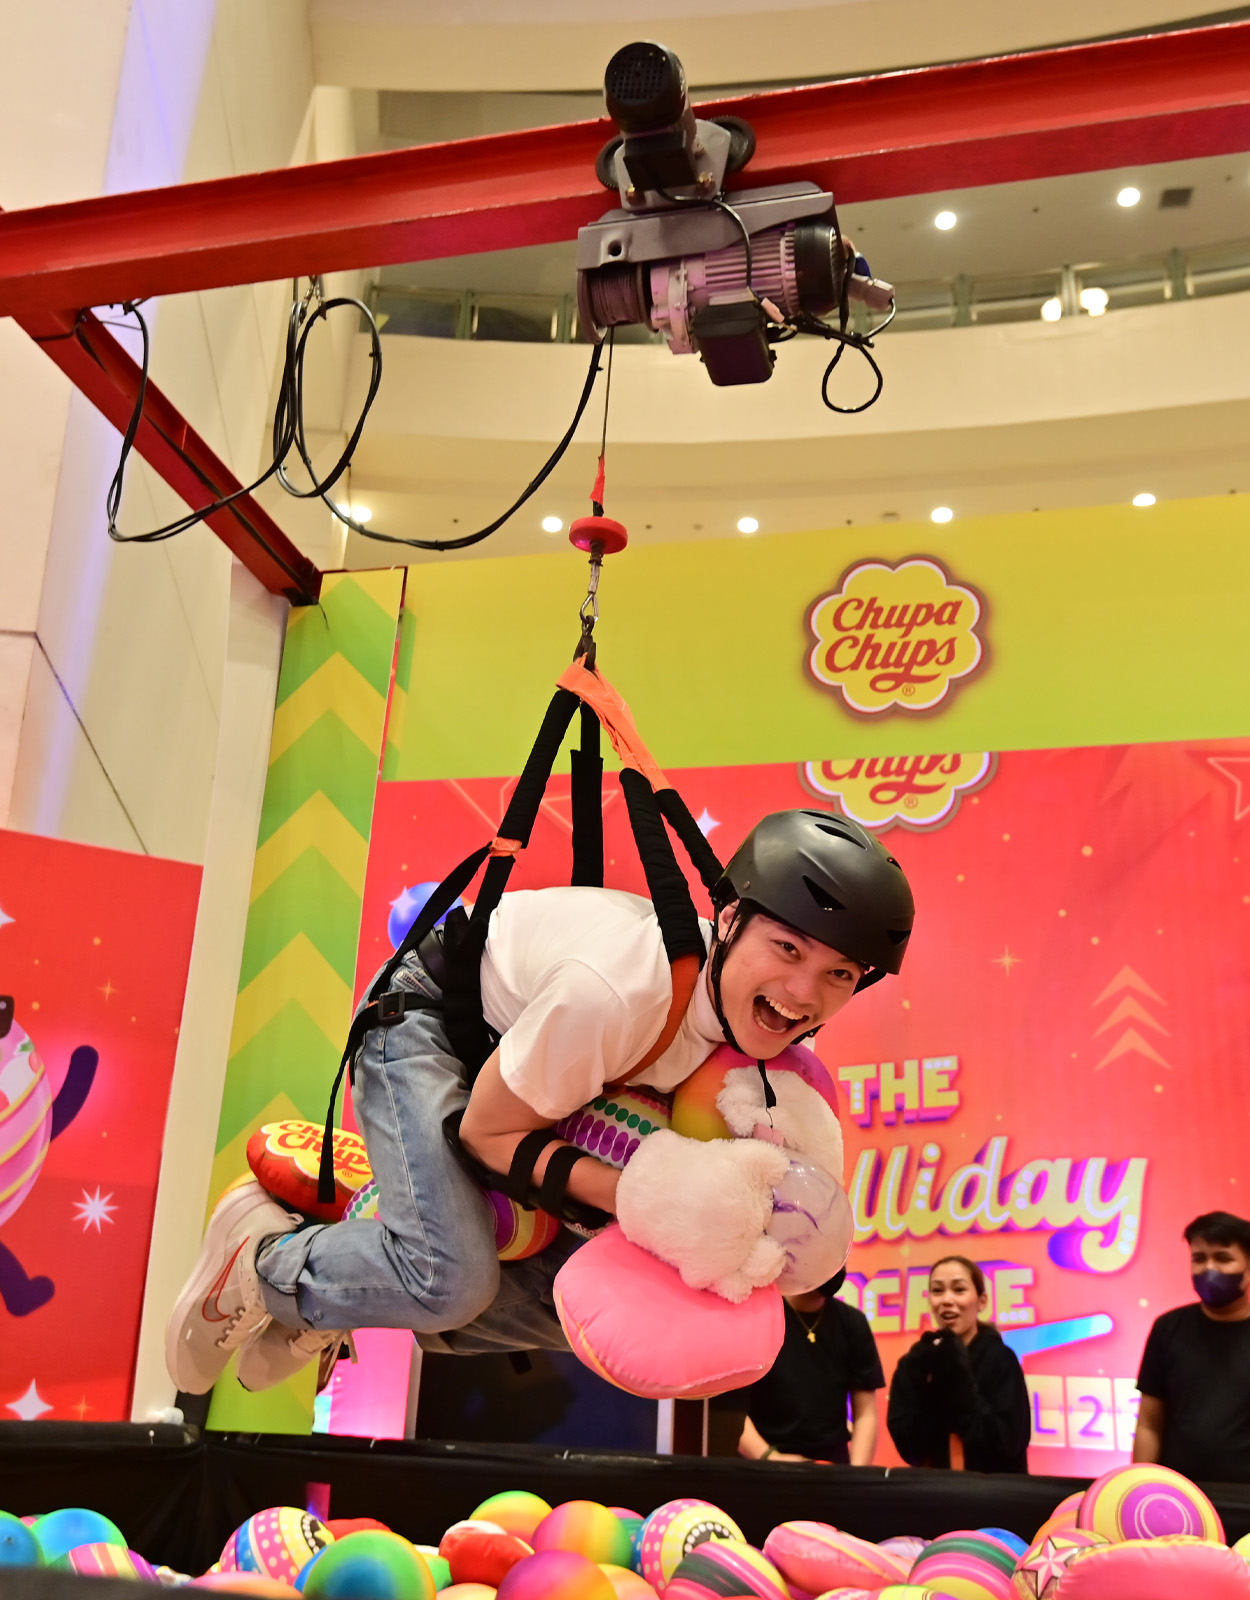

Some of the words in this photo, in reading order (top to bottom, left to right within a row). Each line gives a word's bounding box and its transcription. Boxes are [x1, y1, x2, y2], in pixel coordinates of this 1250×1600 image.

[832, 596, 963, 639] Chupa
[824, 633, 958, 693] Chups
[838, 1055, 960, 1128] THE
[277, 1132, 371, 1175] Chp
[848, 1135, 1148, 1273] lliday
